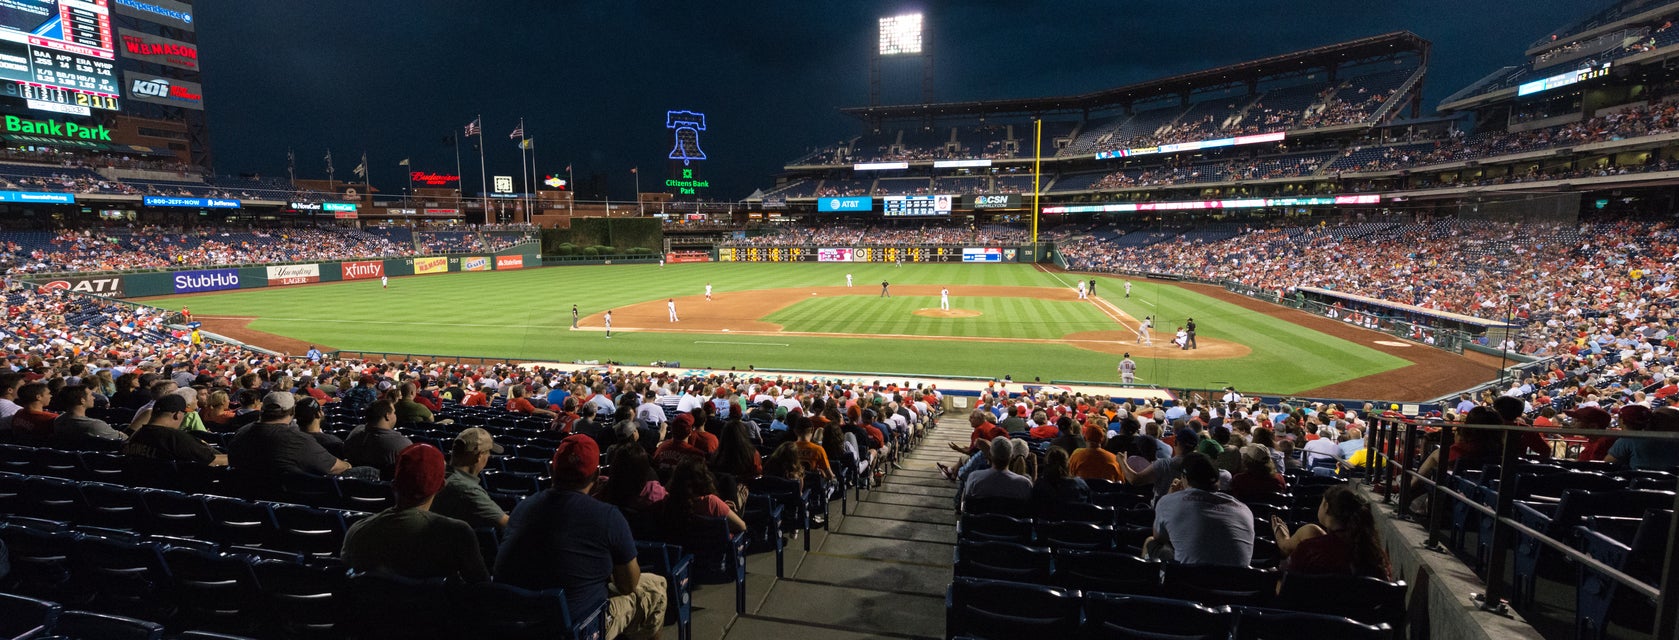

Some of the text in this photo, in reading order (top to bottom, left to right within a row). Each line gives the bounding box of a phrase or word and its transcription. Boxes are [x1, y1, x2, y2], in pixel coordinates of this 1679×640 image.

[34, 50, 51, 58] BAA
[77, 94, 88, 106] 2
[93, 96, 102, 108] 1
[107, 98, 116, 109] 1
[5, 115, 63, 136] Bank
[66, 122, 111, 141] Park
[345, 263, 380, 278] xfinity
[466, 259, 486, 269] Gulf
[72, 278, 119, 292] ATI
[176, 270, 239, 289] StubHub
